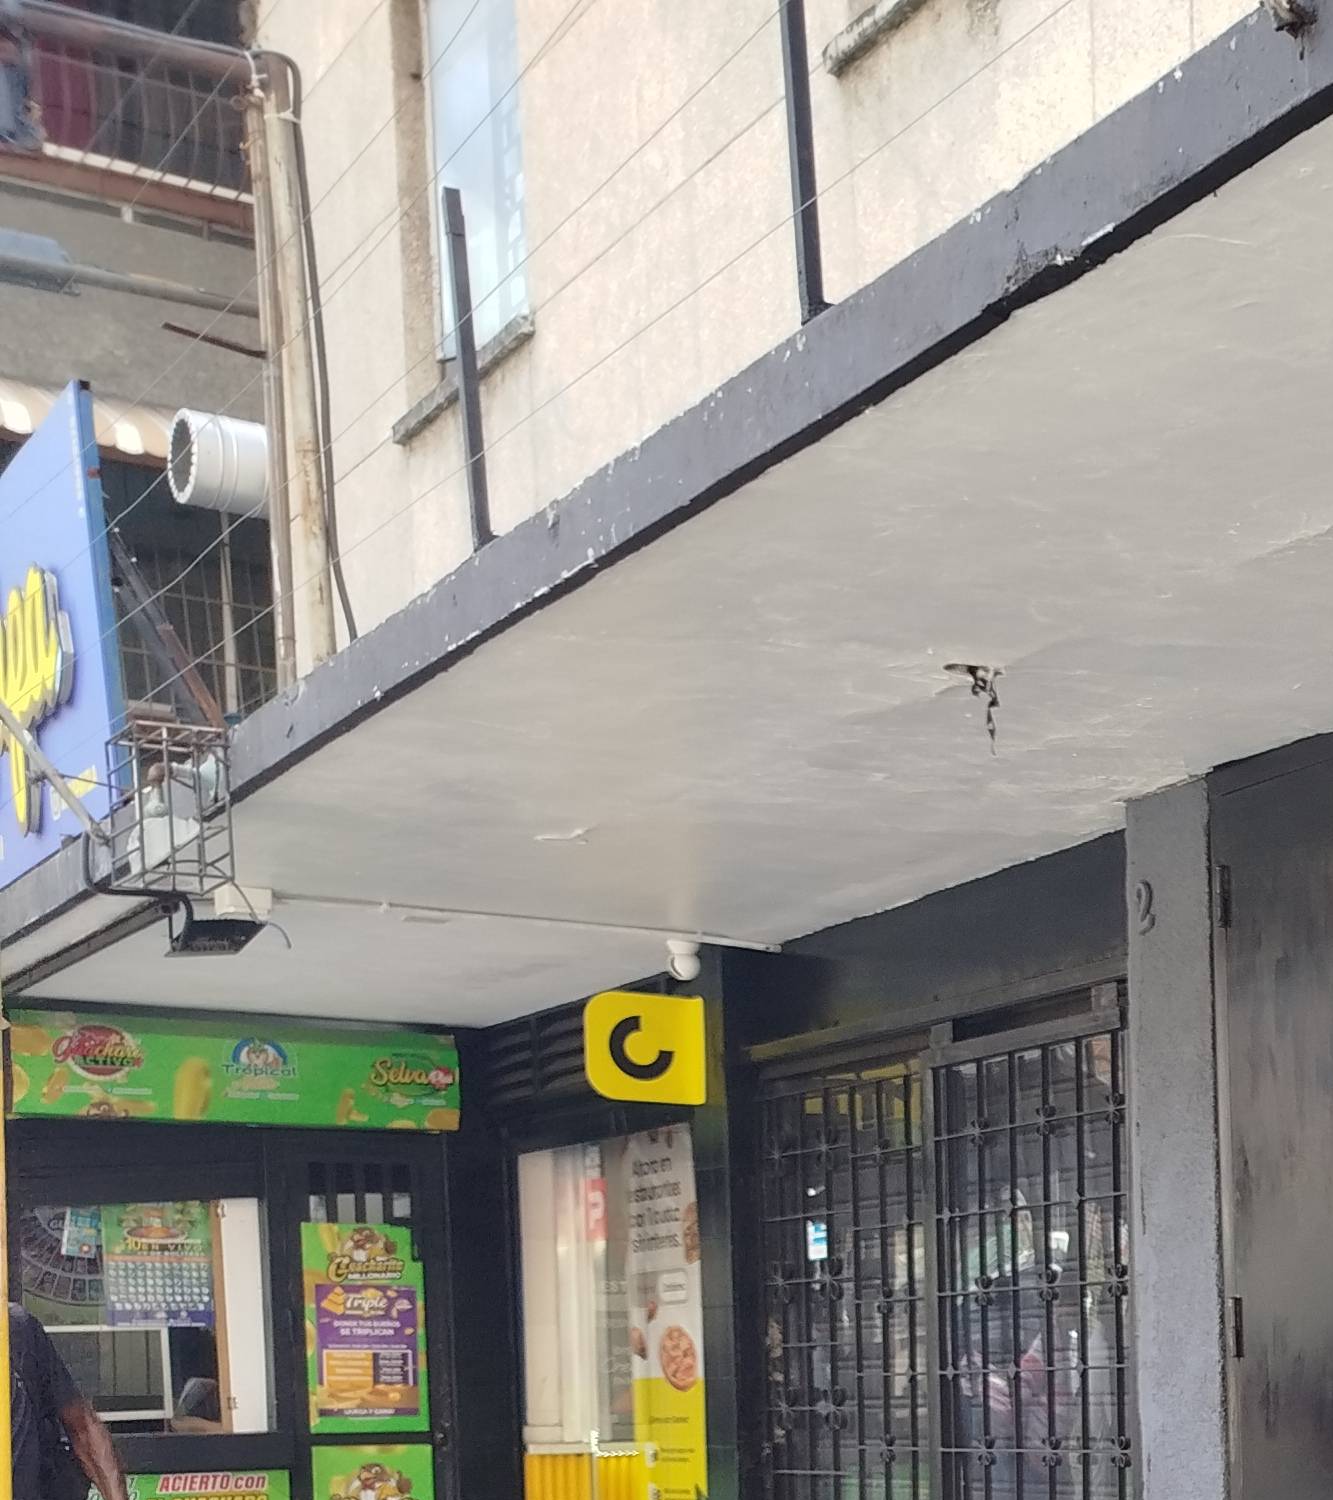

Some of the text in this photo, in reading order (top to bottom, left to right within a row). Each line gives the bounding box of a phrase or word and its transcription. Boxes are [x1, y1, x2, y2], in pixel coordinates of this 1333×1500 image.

[221, 1063, 297, 1077] Tropical
[370, 1059, 430, 1087] Selva
[345, 1294, 388, 1312] Triple
[160, 1474, 266, 1492] ACIERTO con
